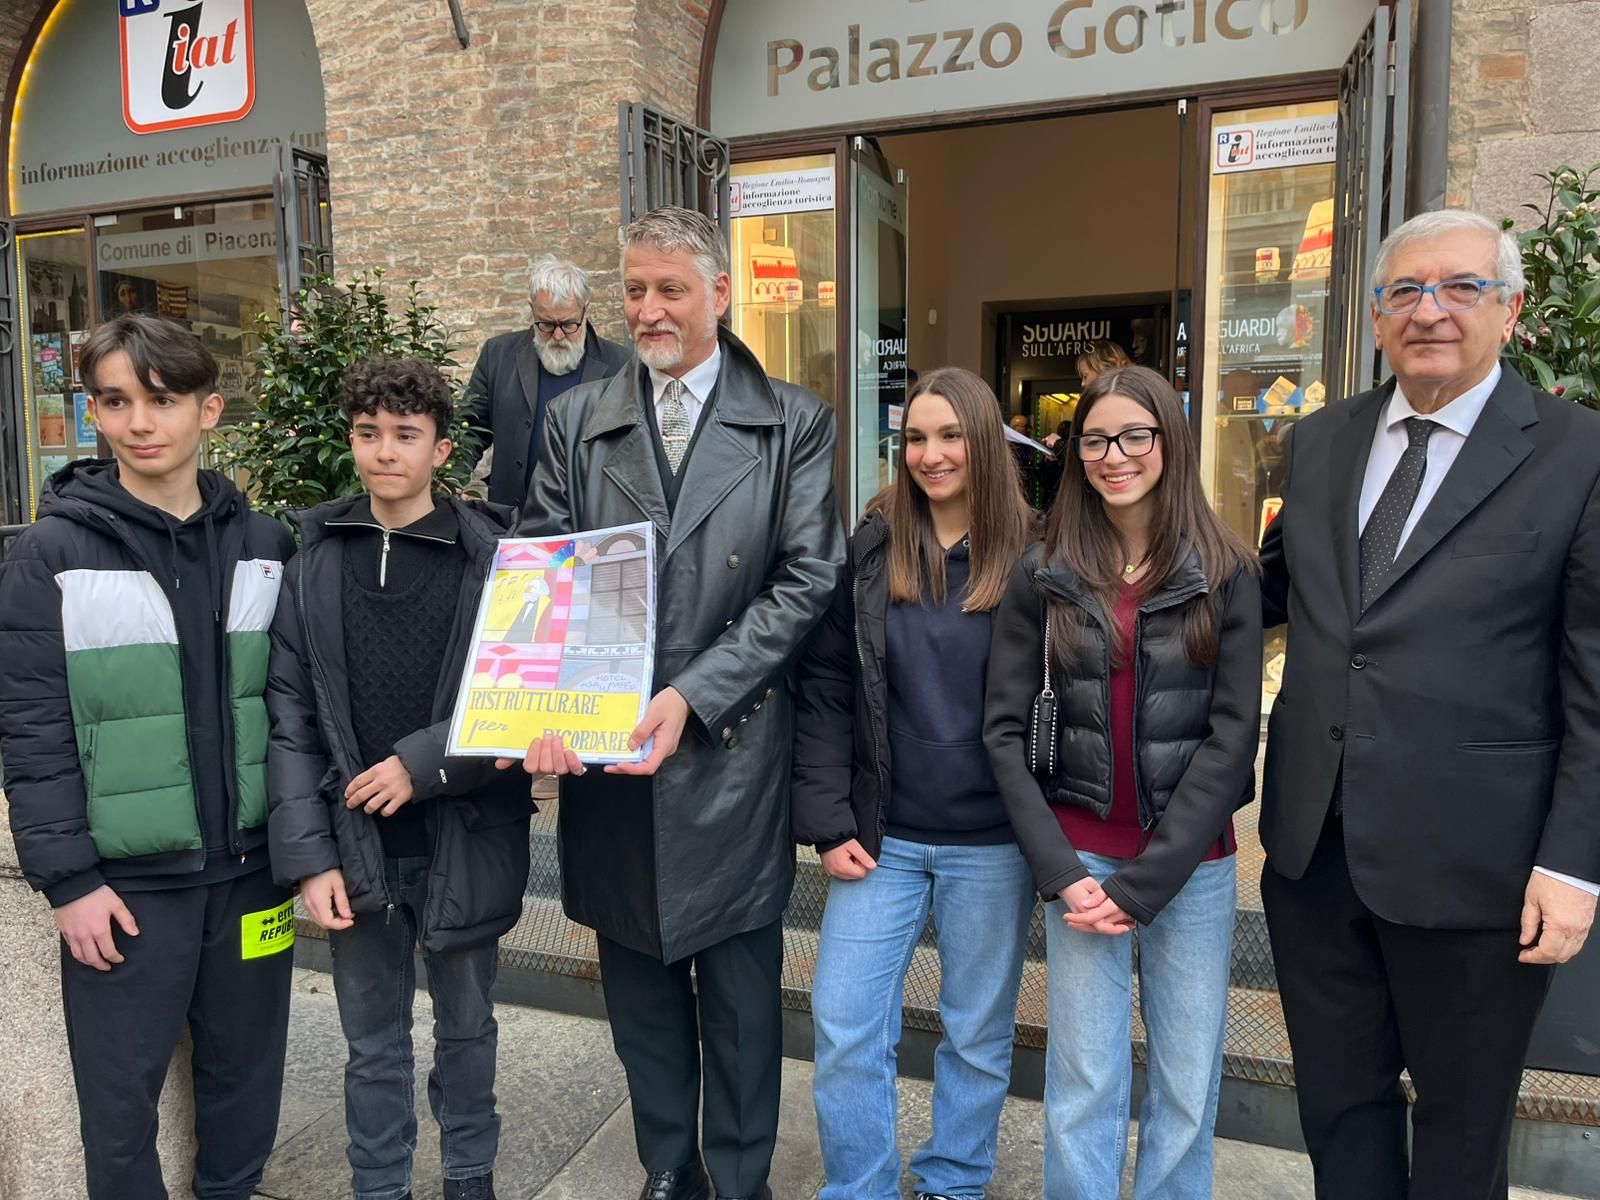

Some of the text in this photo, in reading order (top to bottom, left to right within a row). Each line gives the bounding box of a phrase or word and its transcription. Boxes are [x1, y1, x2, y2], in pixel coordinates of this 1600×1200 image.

[172, 18, 239, 75] iat
[767, 0, 1309, 97] Palazzo Gotico
[1294, 121, 1338, 134] Emilia-R
[1255, 147, 1322, 162] accoglienza
[1256, 135, 1334, 151] informazione
[21, 152, 149, 185] informazione
[742, 189, 801, 200] informazione
[742, 198, 793, 210] accoglienza
[795, 194, 832, 204] turistica
[100, 240, 172, 263] Comune
[176, 235, 192, 255] di
[469, 690, 603, 715] RISTRUTTURARE
[467, 718, 509, 744] per
